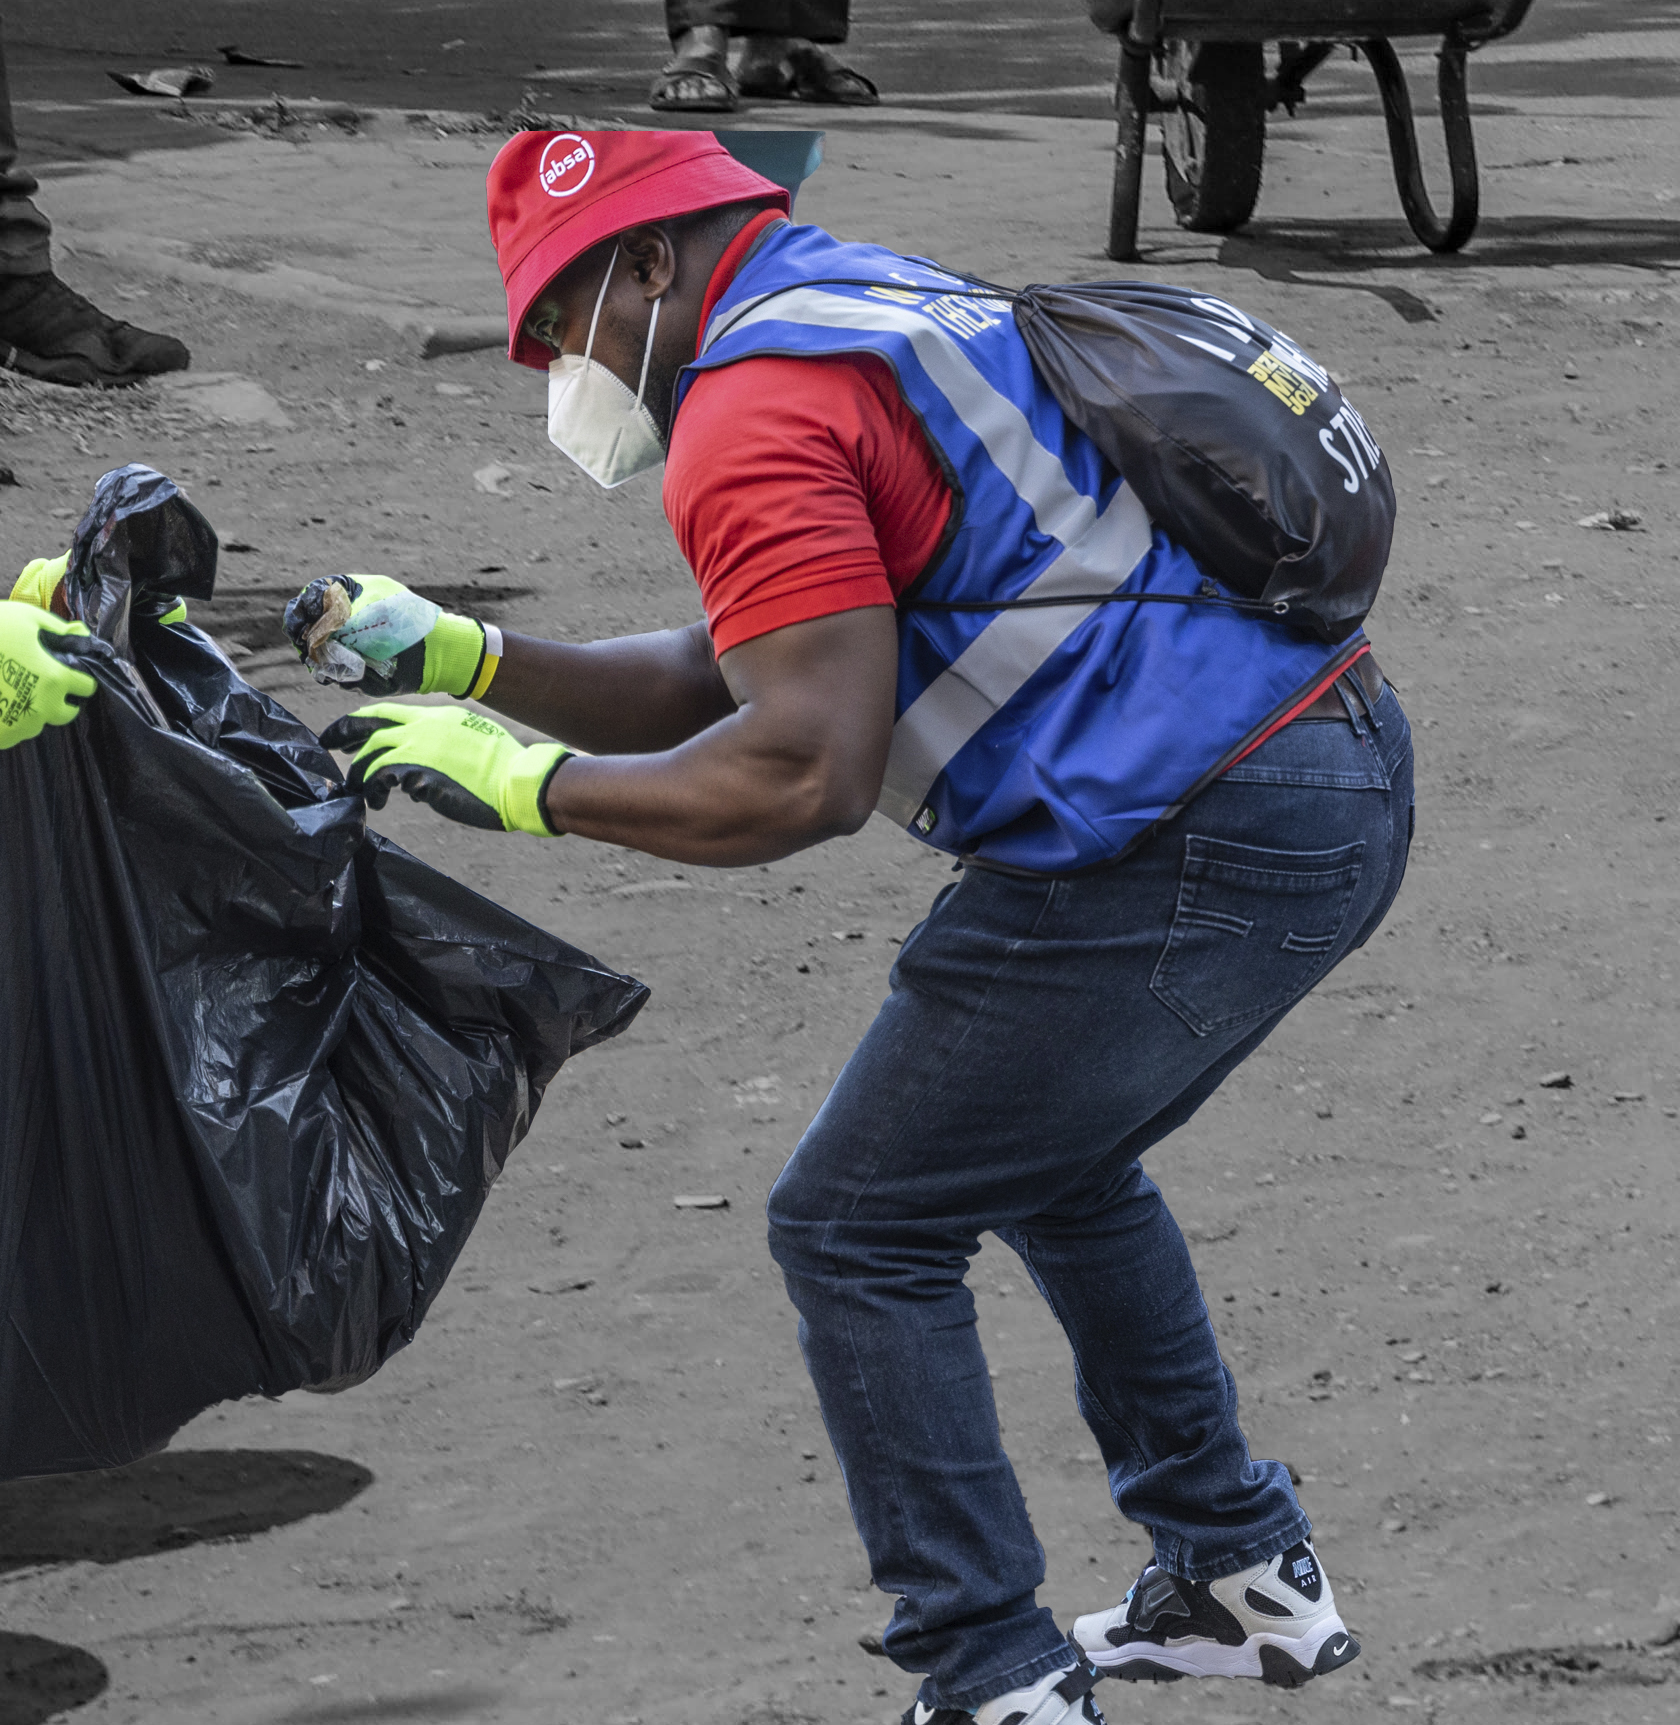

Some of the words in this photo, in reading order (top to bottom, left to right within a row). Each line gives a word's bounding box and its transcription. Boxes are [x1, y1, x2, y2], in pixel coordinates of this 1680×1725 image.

[545, 147, 587, 184] absa
[7, 674, 40, 727] Pinnacle
[1291, 1555, 1314, 1579] NIKE
[1300, 1574, 1317, 1588] AIR
